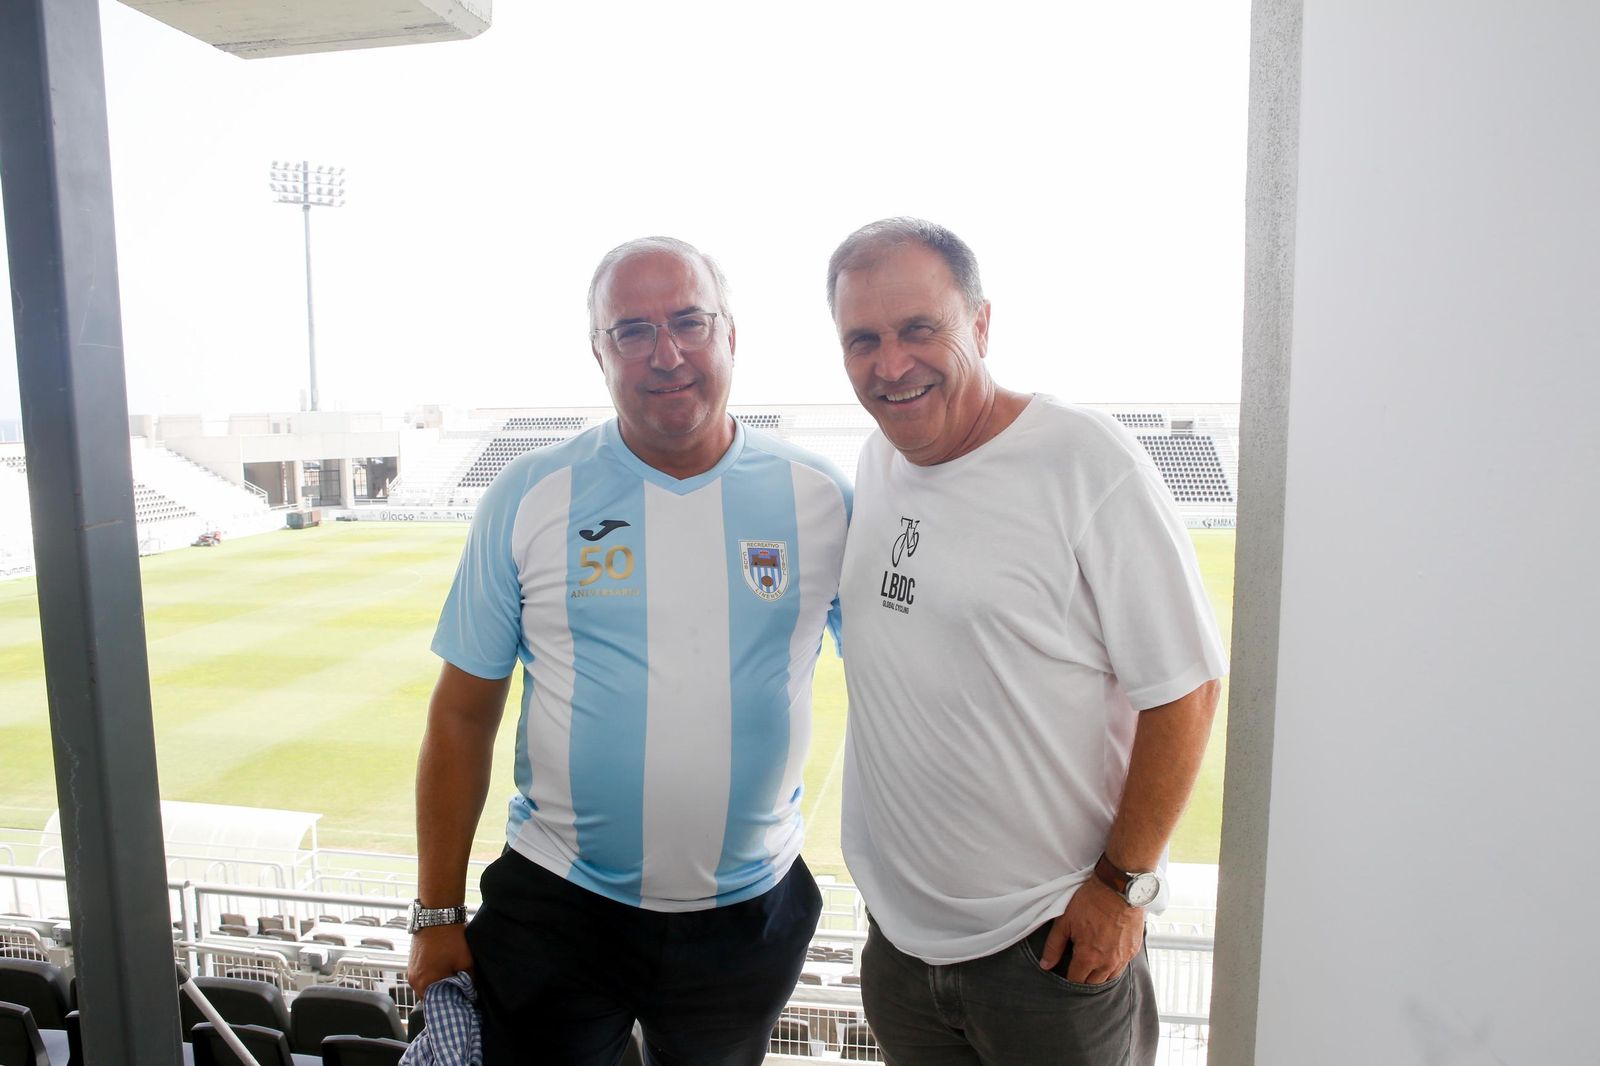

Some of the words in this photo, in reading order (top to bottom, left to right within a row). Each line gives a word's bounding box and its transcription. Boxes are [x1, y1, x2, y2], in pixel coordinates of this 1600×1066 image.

[578, 545, 634, 587] 50
[880, 570, 916, 605] LBDC
[883, 600, 894, 609] GLOBAL
[895, 604, 909, 614] CYCLING
